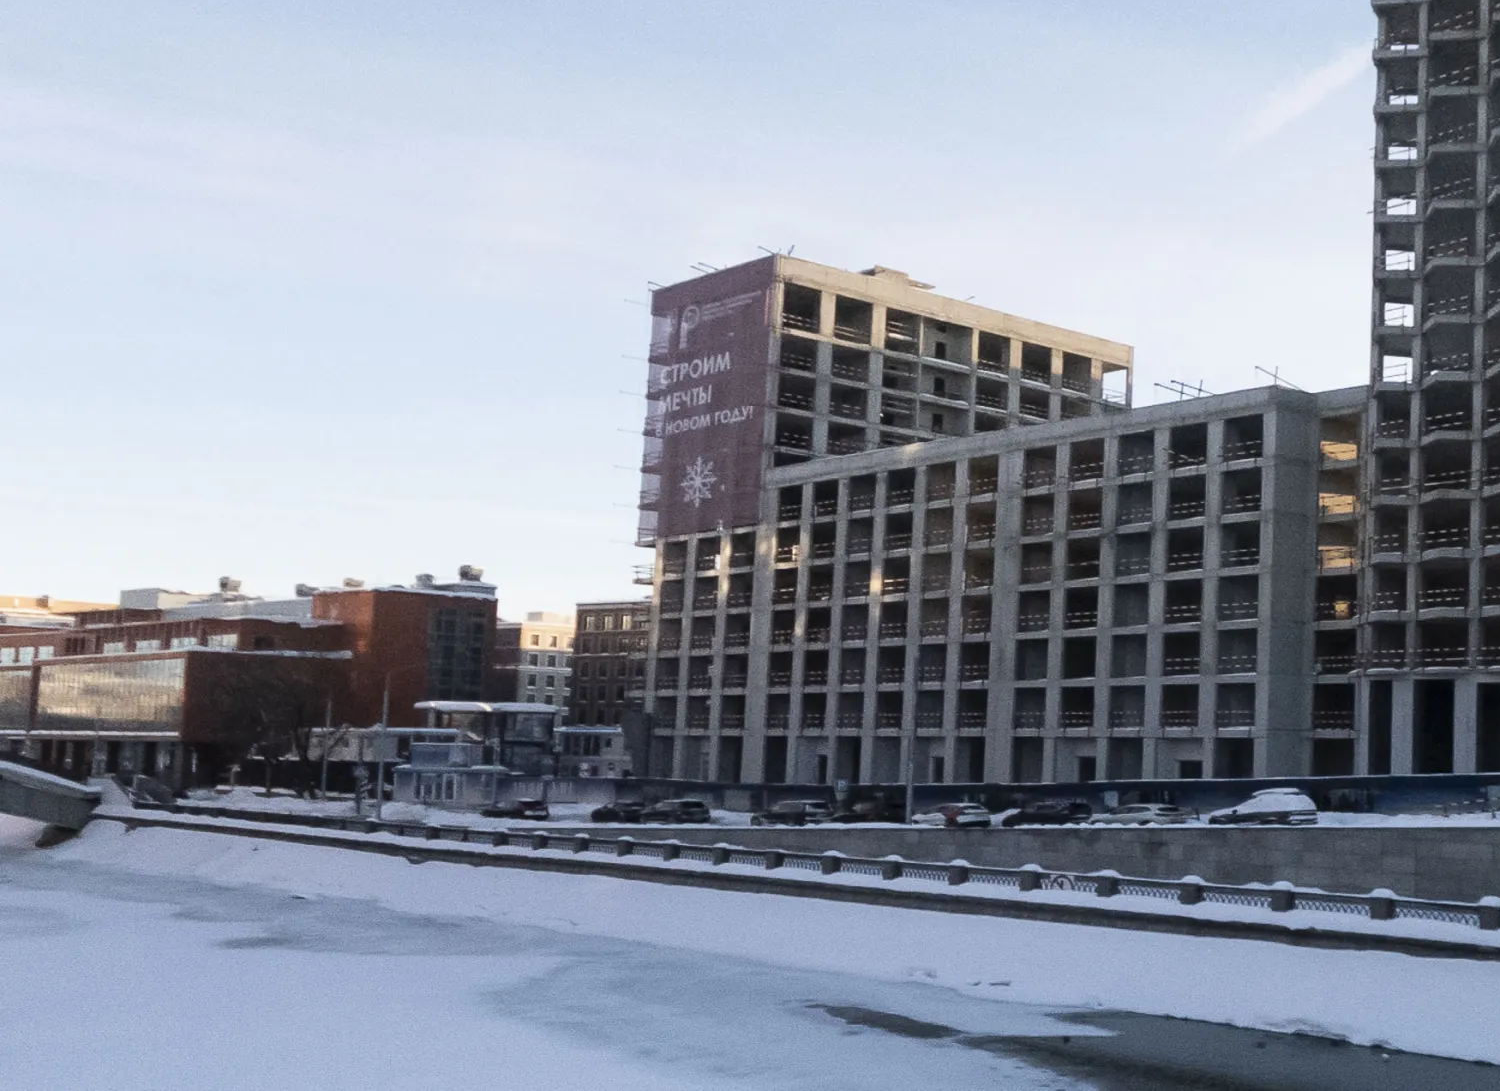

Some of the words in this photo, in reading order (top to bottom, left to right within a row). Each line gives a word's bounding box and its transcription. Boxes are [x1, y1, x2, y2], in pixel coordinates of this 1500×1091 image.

[660, 351, 731, 384] СТРОИМ
[659, 384, 712, 413] МЕЧТЫ
[665, 414, 711, 435] НОВОМ
[714, 405, 754, 425] ГОДУ!
